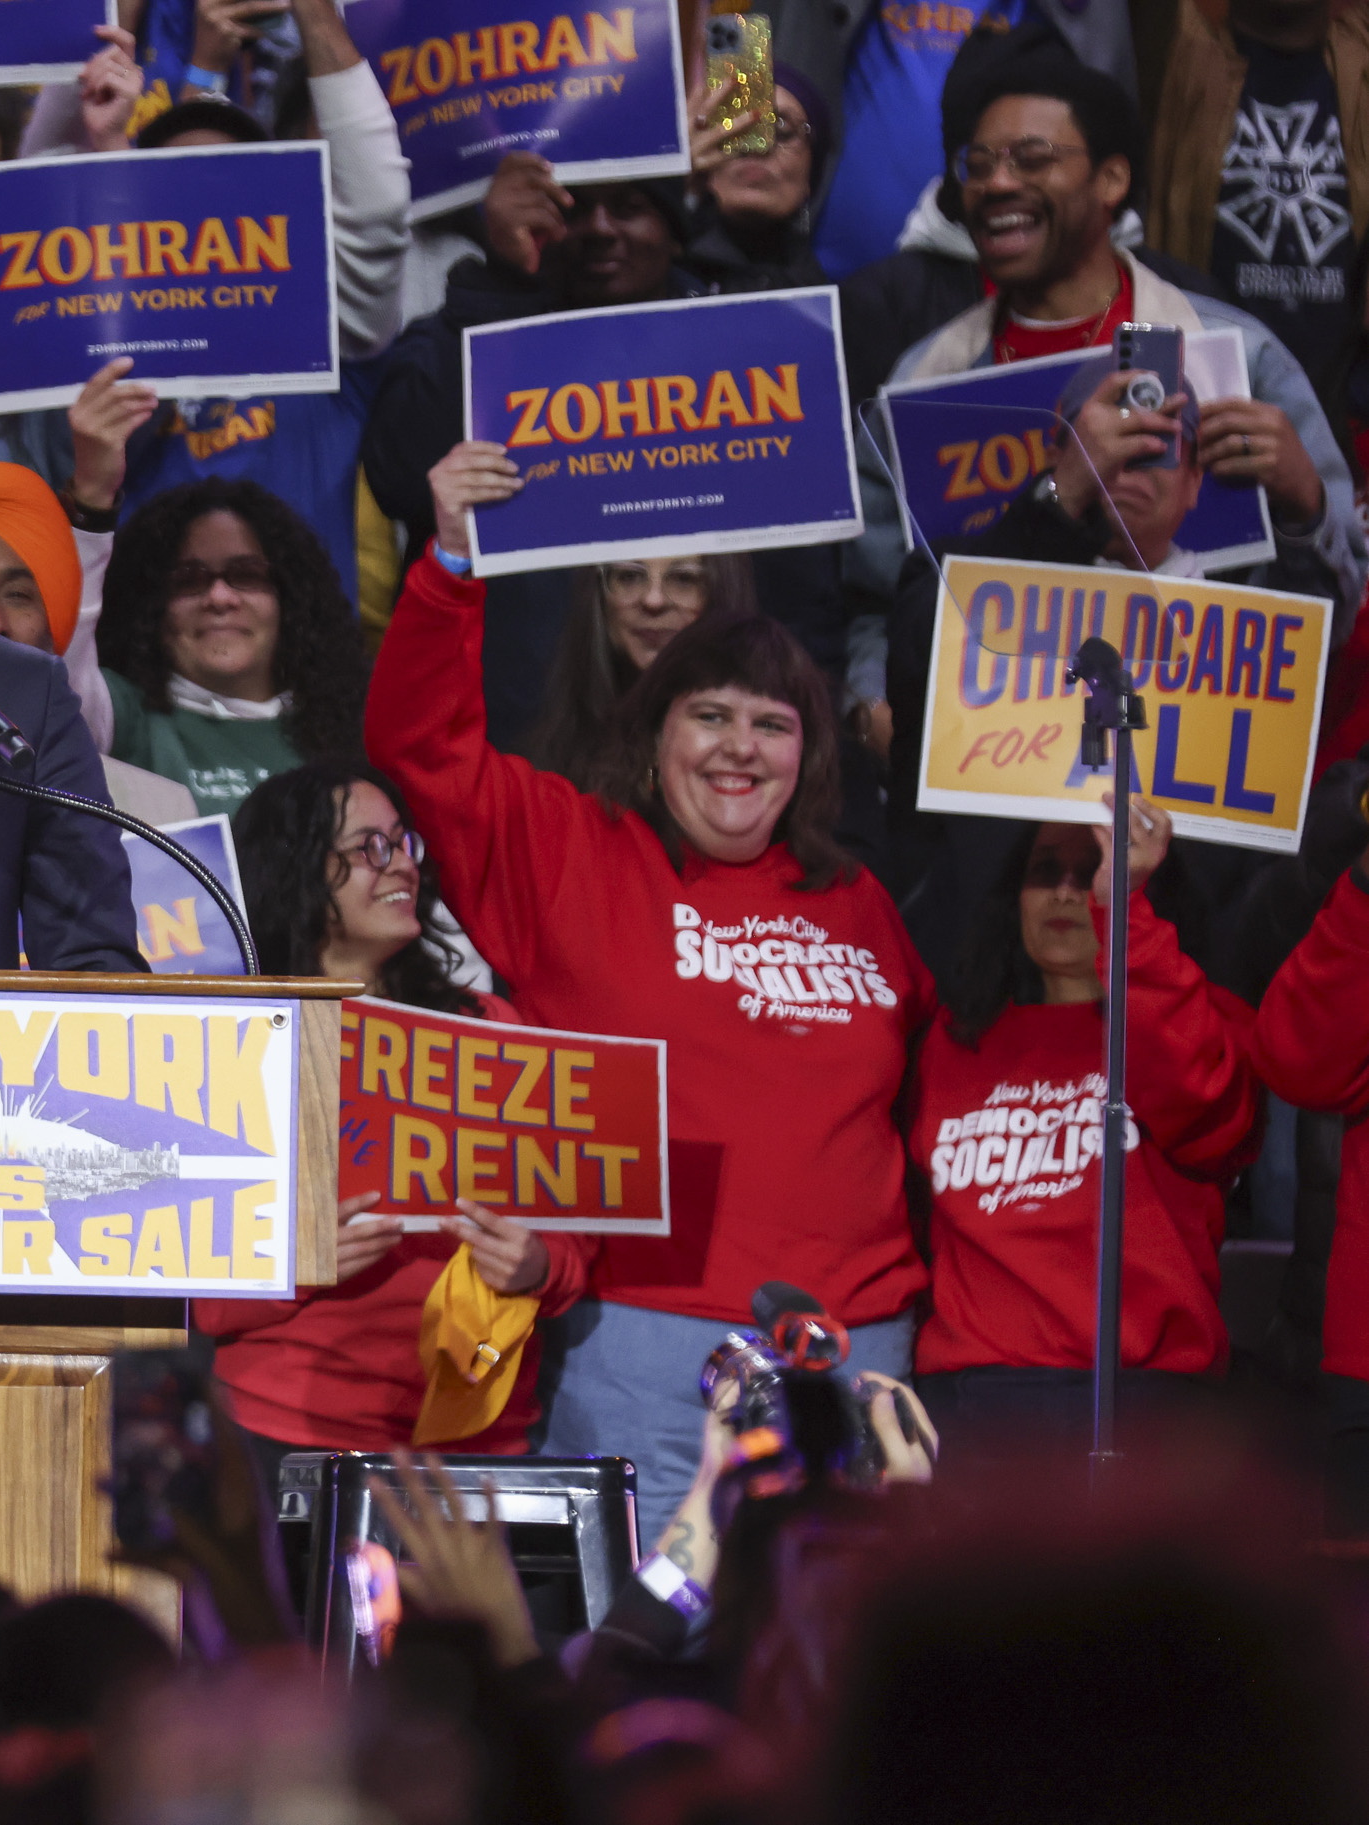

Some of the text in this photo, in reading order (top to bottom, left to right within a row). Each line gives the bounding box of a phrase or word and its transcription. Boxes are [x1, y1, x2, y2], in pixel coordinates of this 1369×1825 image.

[381, 8, 638, 108] ZOHRAN
[431, 94, 483, 126] NEW
[486, 80, 559, 110] YORK
[560, 73, 626, 99] CITY
[56, 292, 124, 319] NEW
[129, 287, 208, 311] YORK
[212, 285, 279, 309] CITY
[86, 337, 209, 357] ZOHRANFORNYC.COM
[504, 363, 805, 449] ZOHRAN
[568, 449, 636, 478] NEW
[640, 441, 719, 470] YORK
[725, 435, 793, 461] CITY
[601, 493, 725, 517] ZOHRANFORNYC.COM
[957, 722, 1064, 775] FOR
[738, 993, 853, 1024] of America
[388, 1112, 641, 1209] RENT
[78, 1179, 277, 1280] SALE
